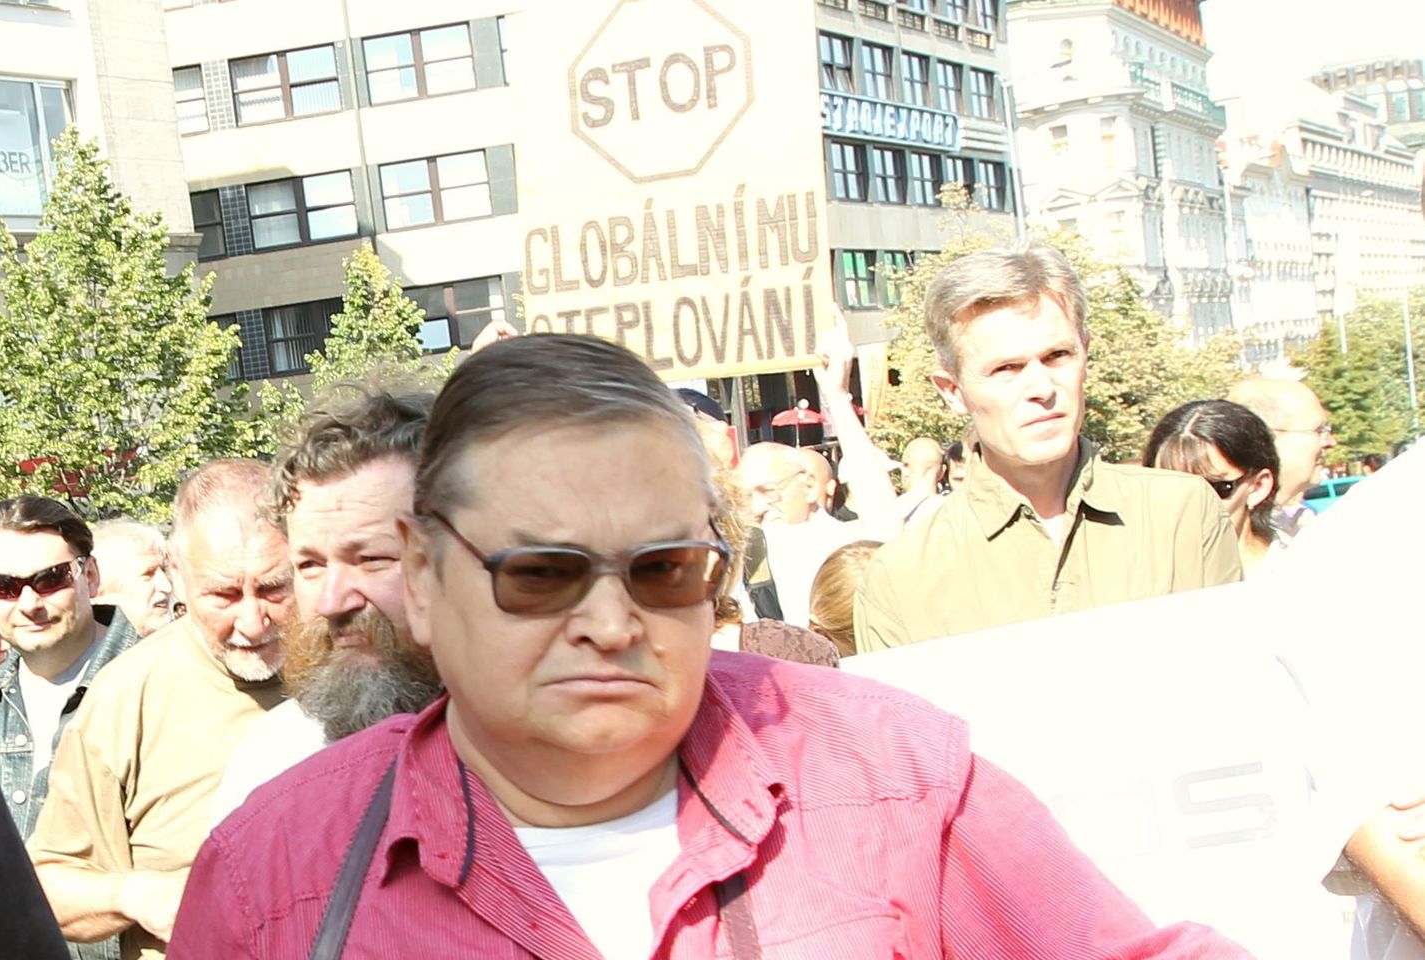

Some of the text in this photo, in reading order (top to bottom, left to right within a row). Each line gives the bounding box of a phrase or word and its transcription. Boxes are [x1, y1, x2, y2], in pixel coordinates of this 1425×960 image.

[578, 44, 736, 129] STOP
[525, 184, 819, 296] GLOBÁLNÍMU
[531, 266, 816, 370] PLOVÁNÍ
